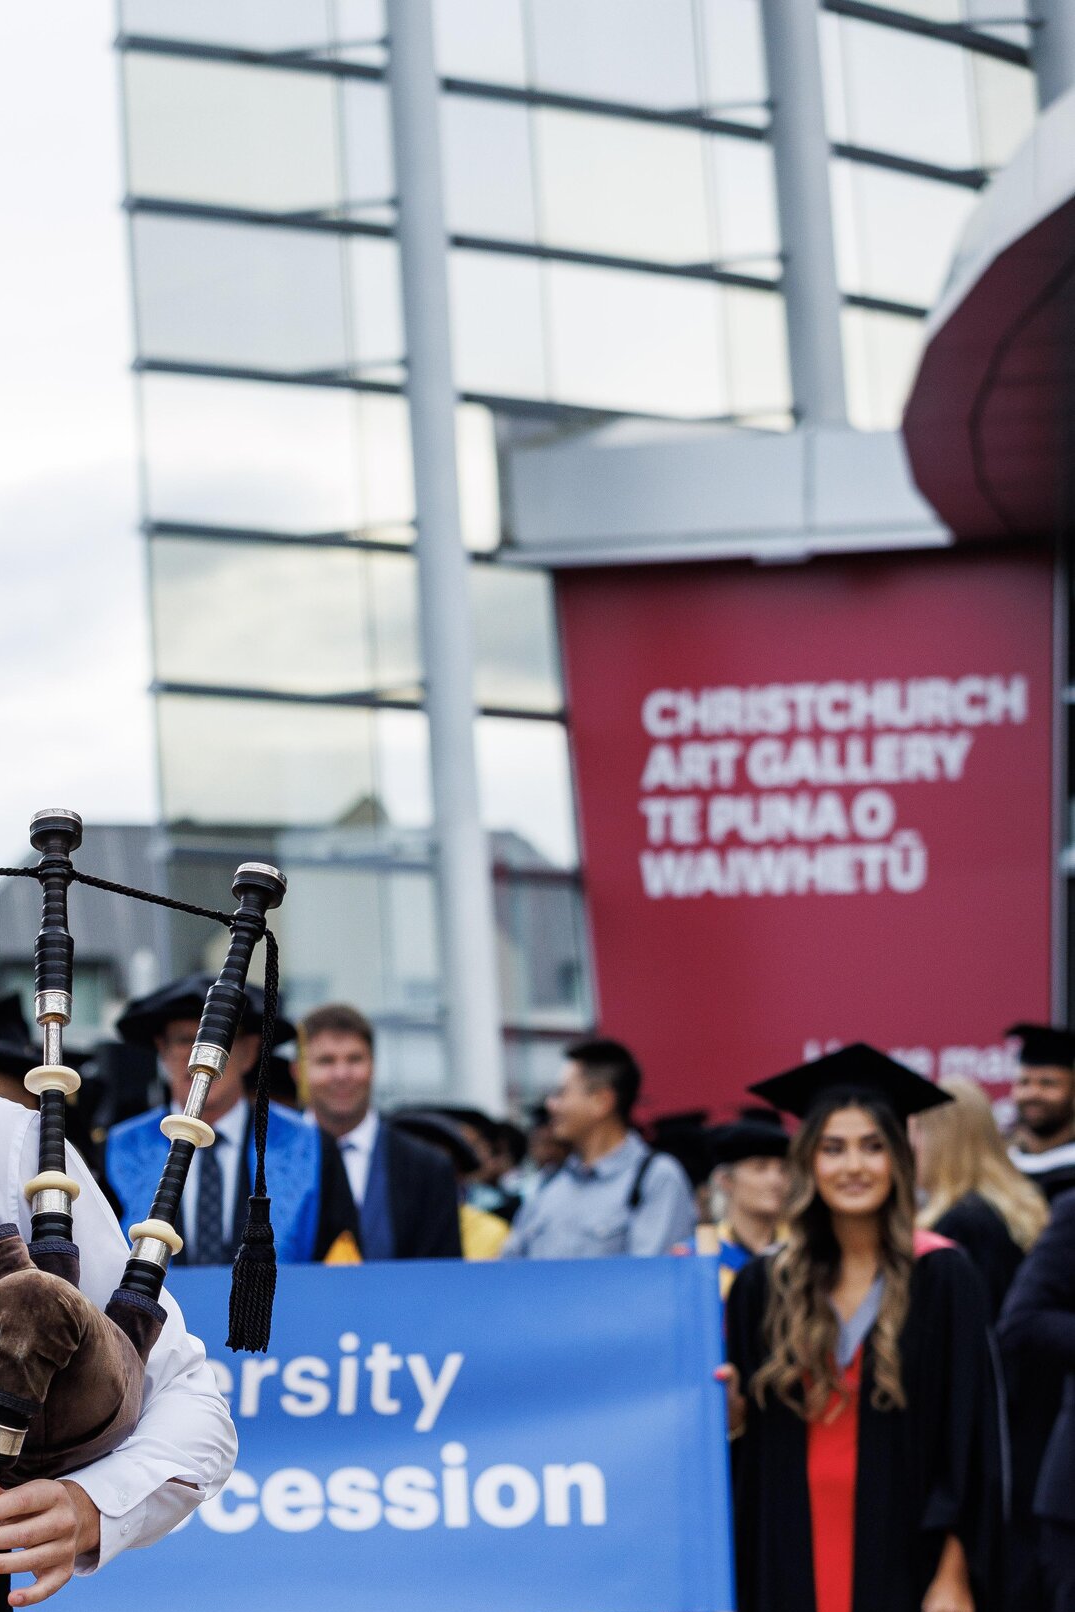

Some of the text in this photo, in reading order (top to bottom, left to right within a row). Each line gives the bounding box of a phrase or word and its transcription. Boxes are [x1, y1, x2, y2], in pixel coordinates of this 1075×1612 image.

[642, 676, 1027, 738] CHRISTCHURCH
[642, 731, 972, 791] ART GALLERY
[641, 788, 895, 845] TE PUNA O
[171, 1441, 607, 1534] cession
